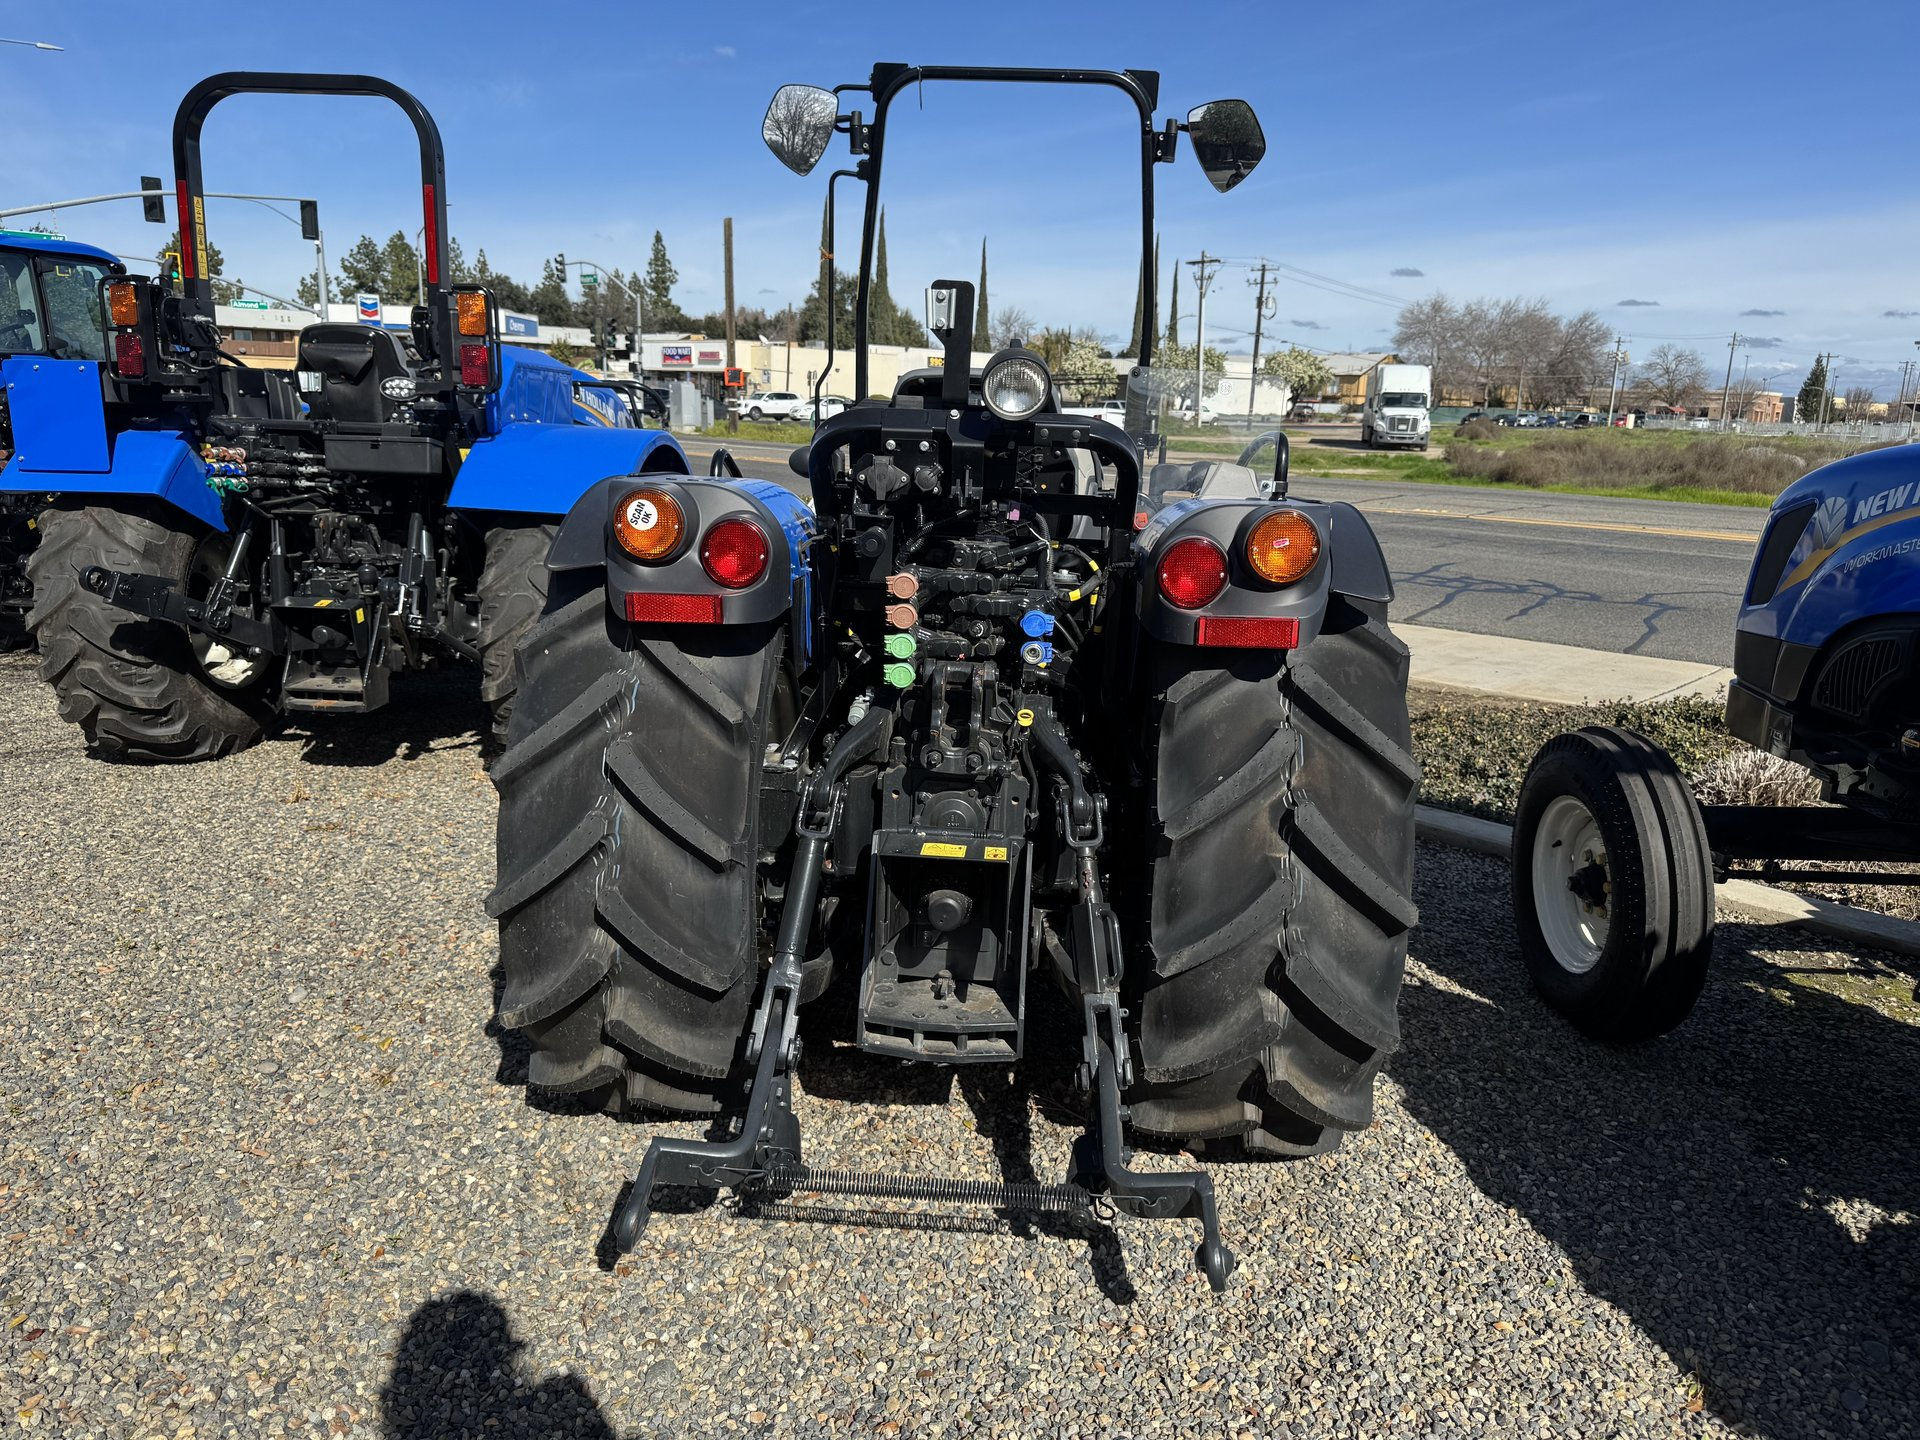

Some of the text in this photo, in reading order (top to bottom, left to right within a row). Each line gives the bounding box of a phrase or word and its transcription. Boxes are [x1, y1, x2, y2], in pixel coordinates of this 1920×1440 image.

[663, 347, 691, 355] FOOD MART
[585, 390, 615, 423] HOLLAND
[630, 502, 646, 525] SCAN
[1852, 482, 1914, 524] NEW
[641, 511, 652, 524] OK
